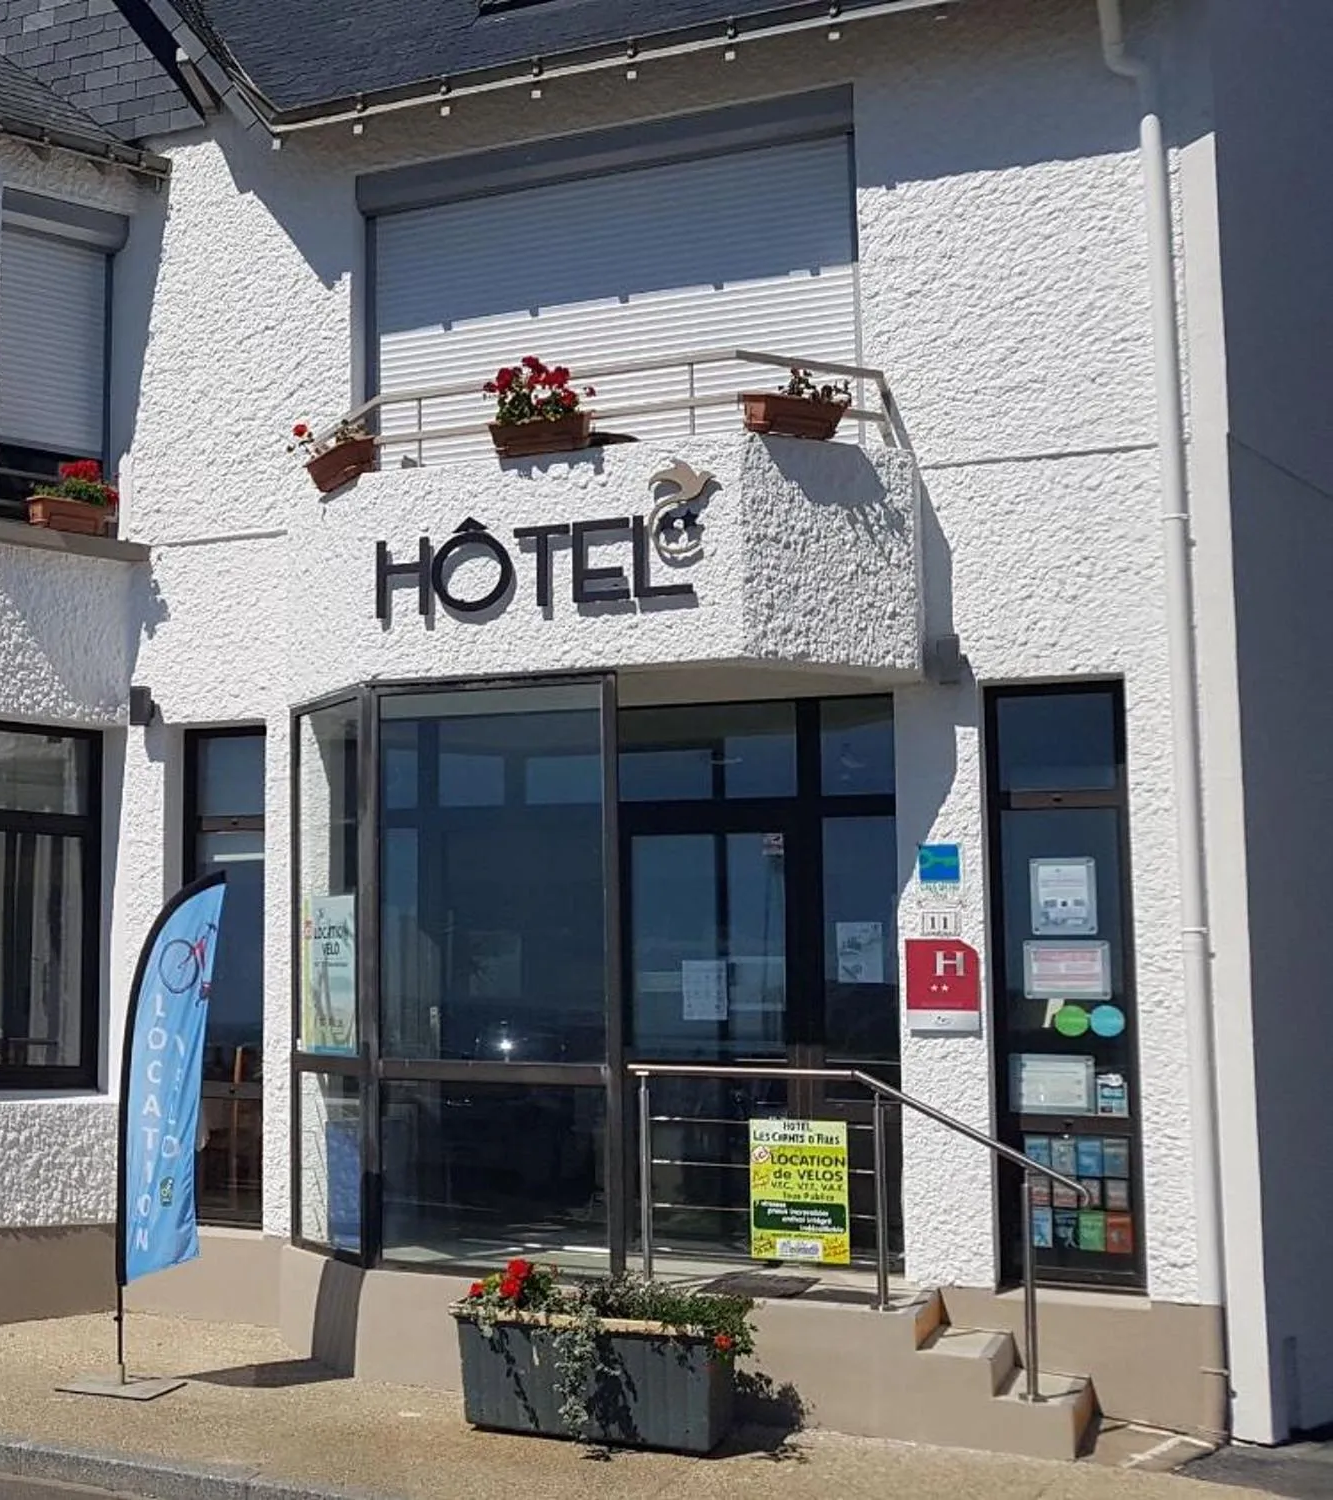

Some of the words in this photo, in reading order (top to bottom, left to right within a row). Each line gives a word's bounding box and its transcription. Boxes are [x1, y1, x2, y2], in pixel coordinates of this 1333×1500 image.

[376, 515, 694, 619] HÔTEL
[933, 950, 966, 977] H
[134, 993, 168, 1252] LOCATION
[771, 1153, 845, 1168] LOCATION
[773, 1168, 792, 1179] de
